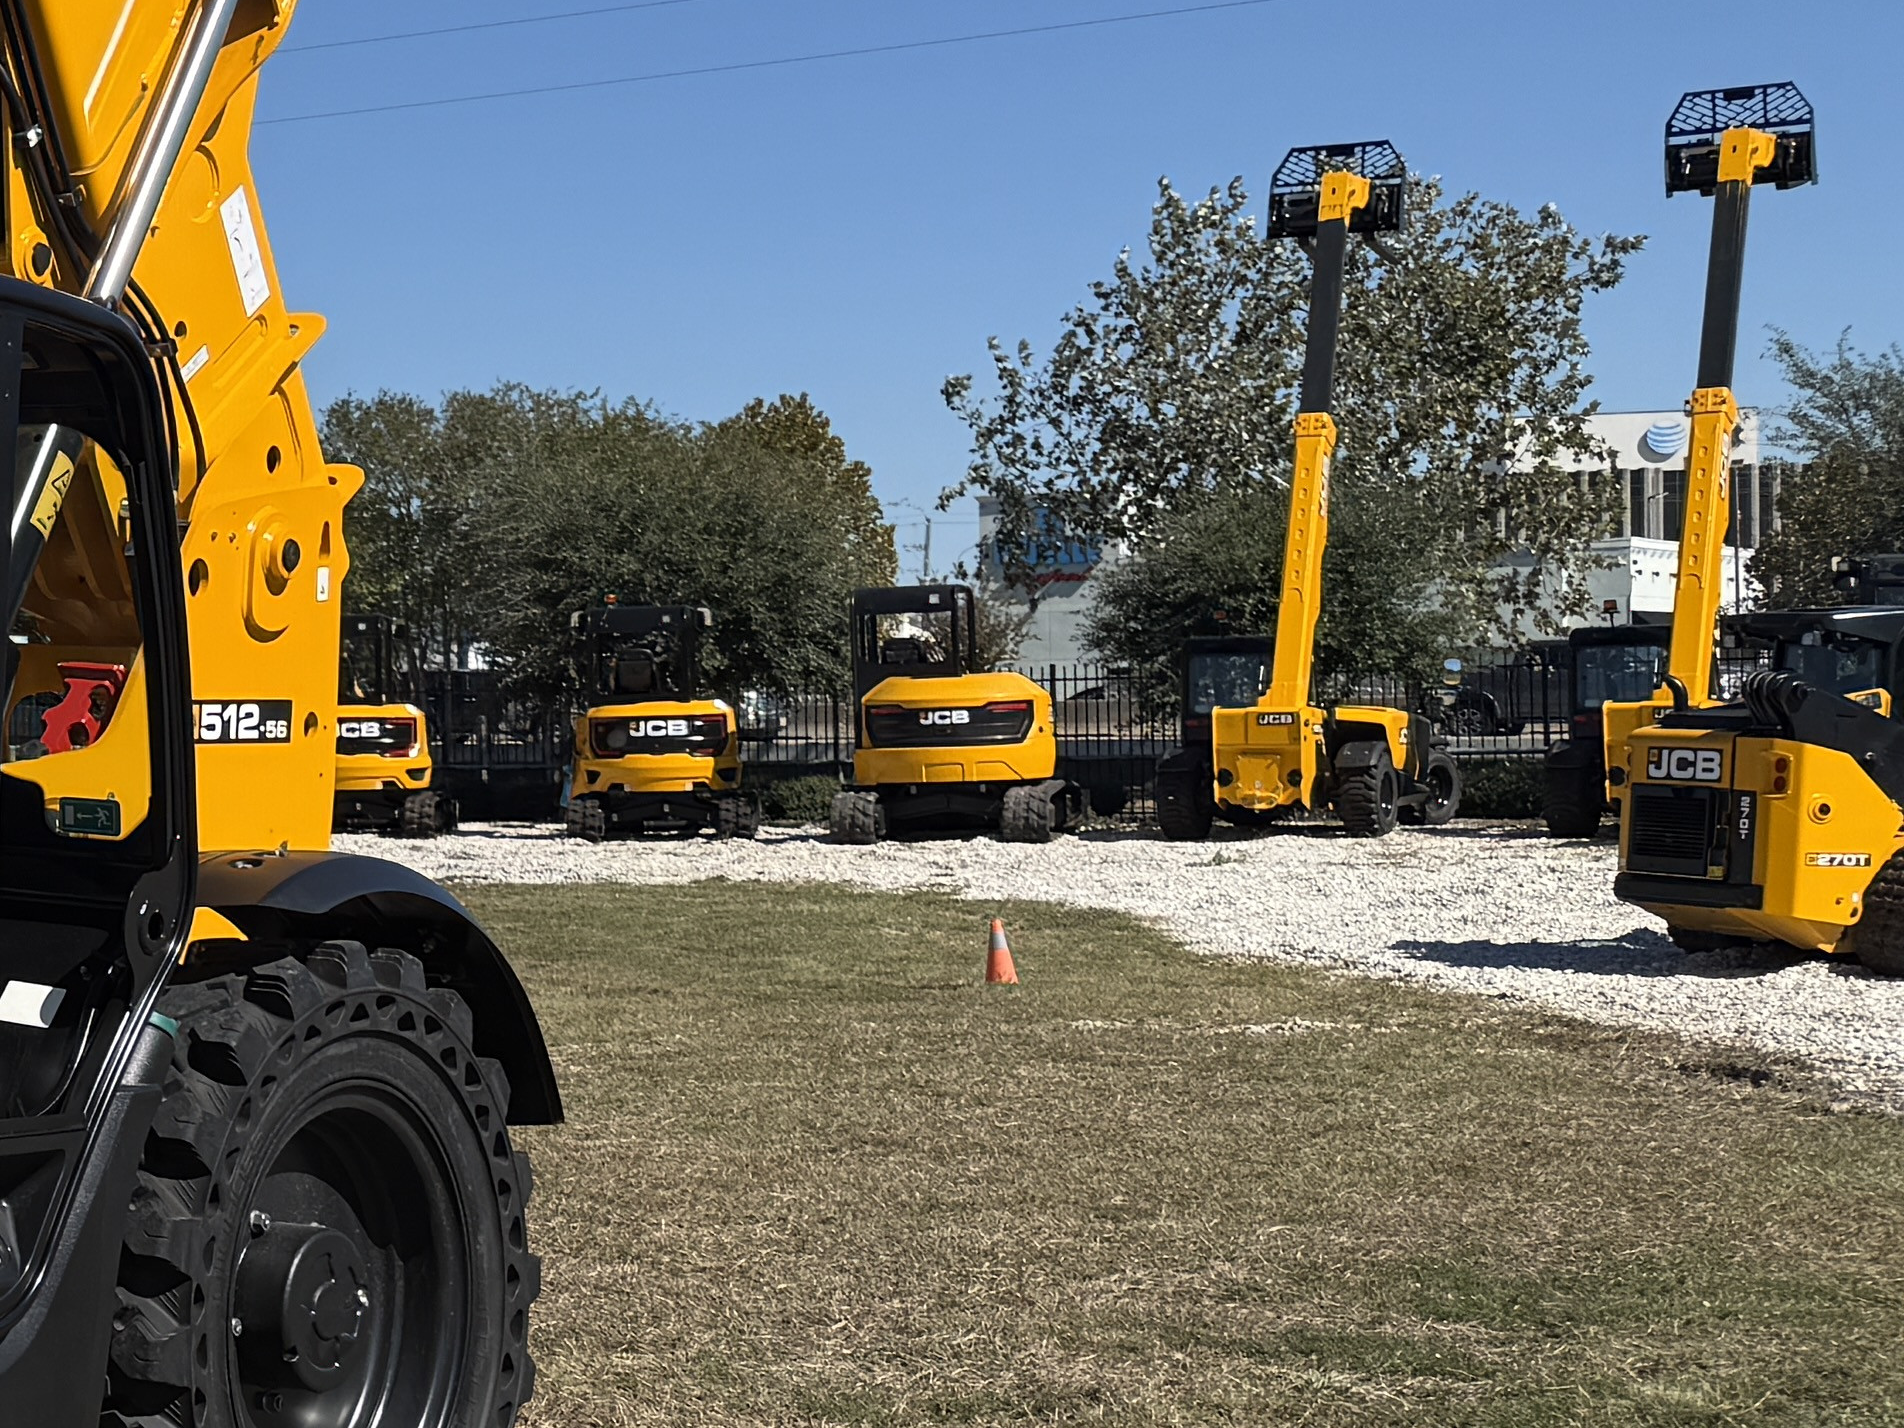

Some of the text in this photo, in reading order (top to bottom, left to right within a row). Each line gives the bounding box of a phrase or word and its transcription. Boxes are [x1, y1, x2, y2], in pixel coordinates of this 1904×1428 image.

[919, 709, 970, 726] JCB
[1258, 714, 1292, 725] JCB
[629, 719, 689, 737] JCB
[1648, 749, 1721, 780] JCB
